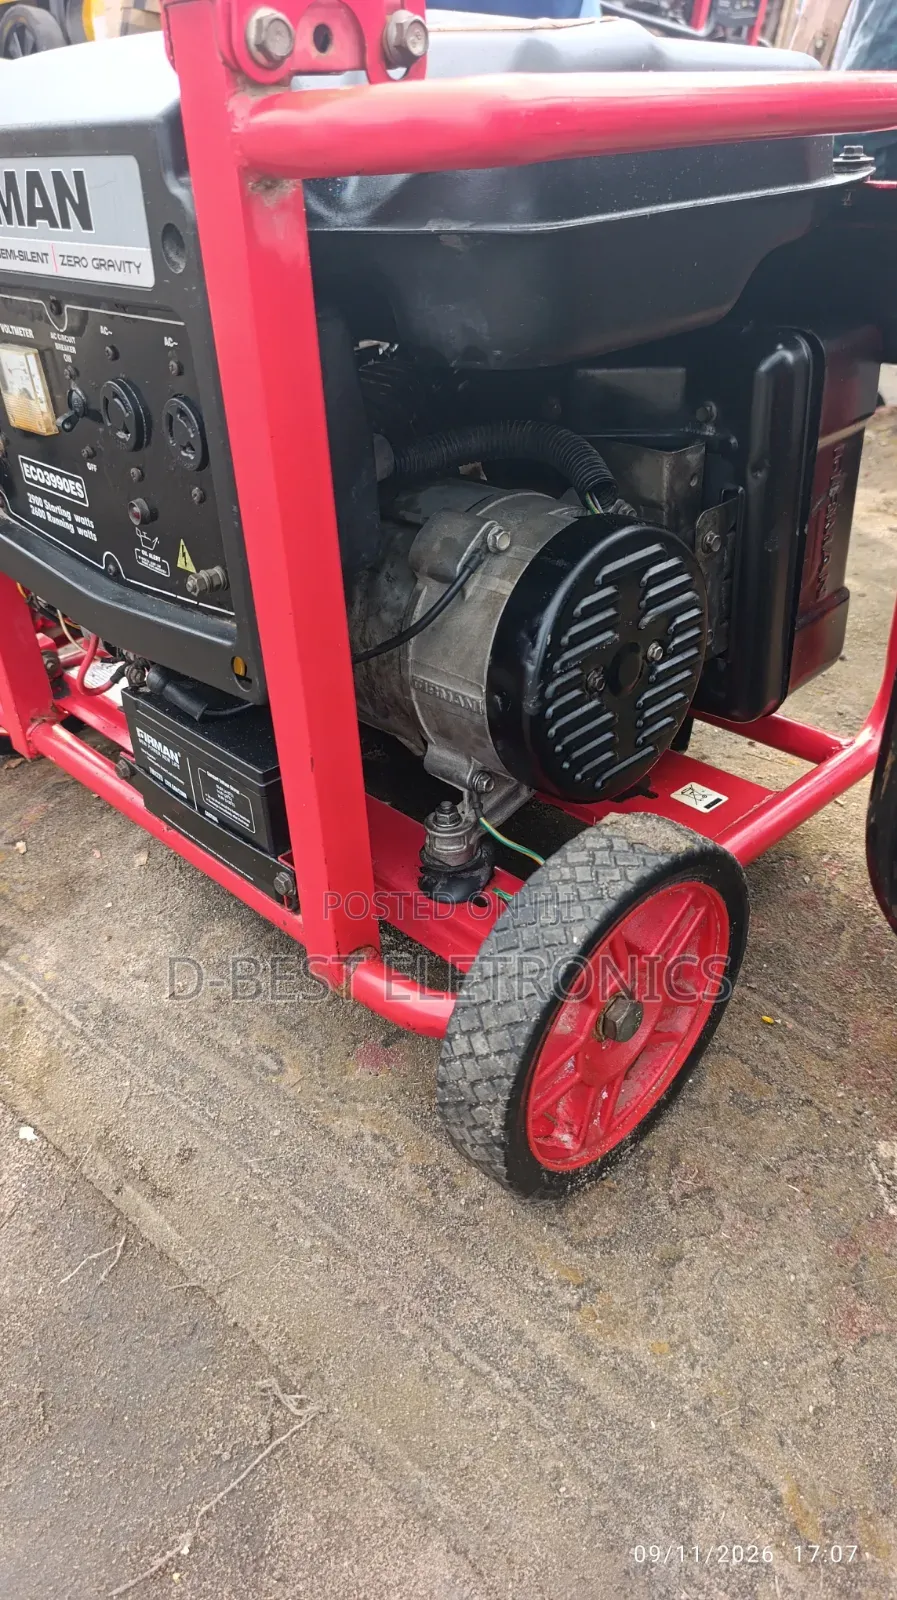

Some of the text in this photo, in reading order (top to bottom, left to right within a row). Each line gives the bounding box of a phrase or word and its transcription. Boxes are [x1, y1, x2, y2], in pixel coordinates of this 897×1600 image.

[0, 168, 95, 233] MAN
[0, 248, 142, 275] EMI-SILENT ZERO GRAVITY
[0, 323, 35, 339] VOLTMETER
[22, 462, 85, 499] ECO3990ES
[86, 462, 98, 472] OFF
[27, 492, 44, 508] 2900
[73, 513, 95, 529] watts
[30, 504, 98, 542] 2600 Running watts
[135, 726, 180, 765] FIRMAN
